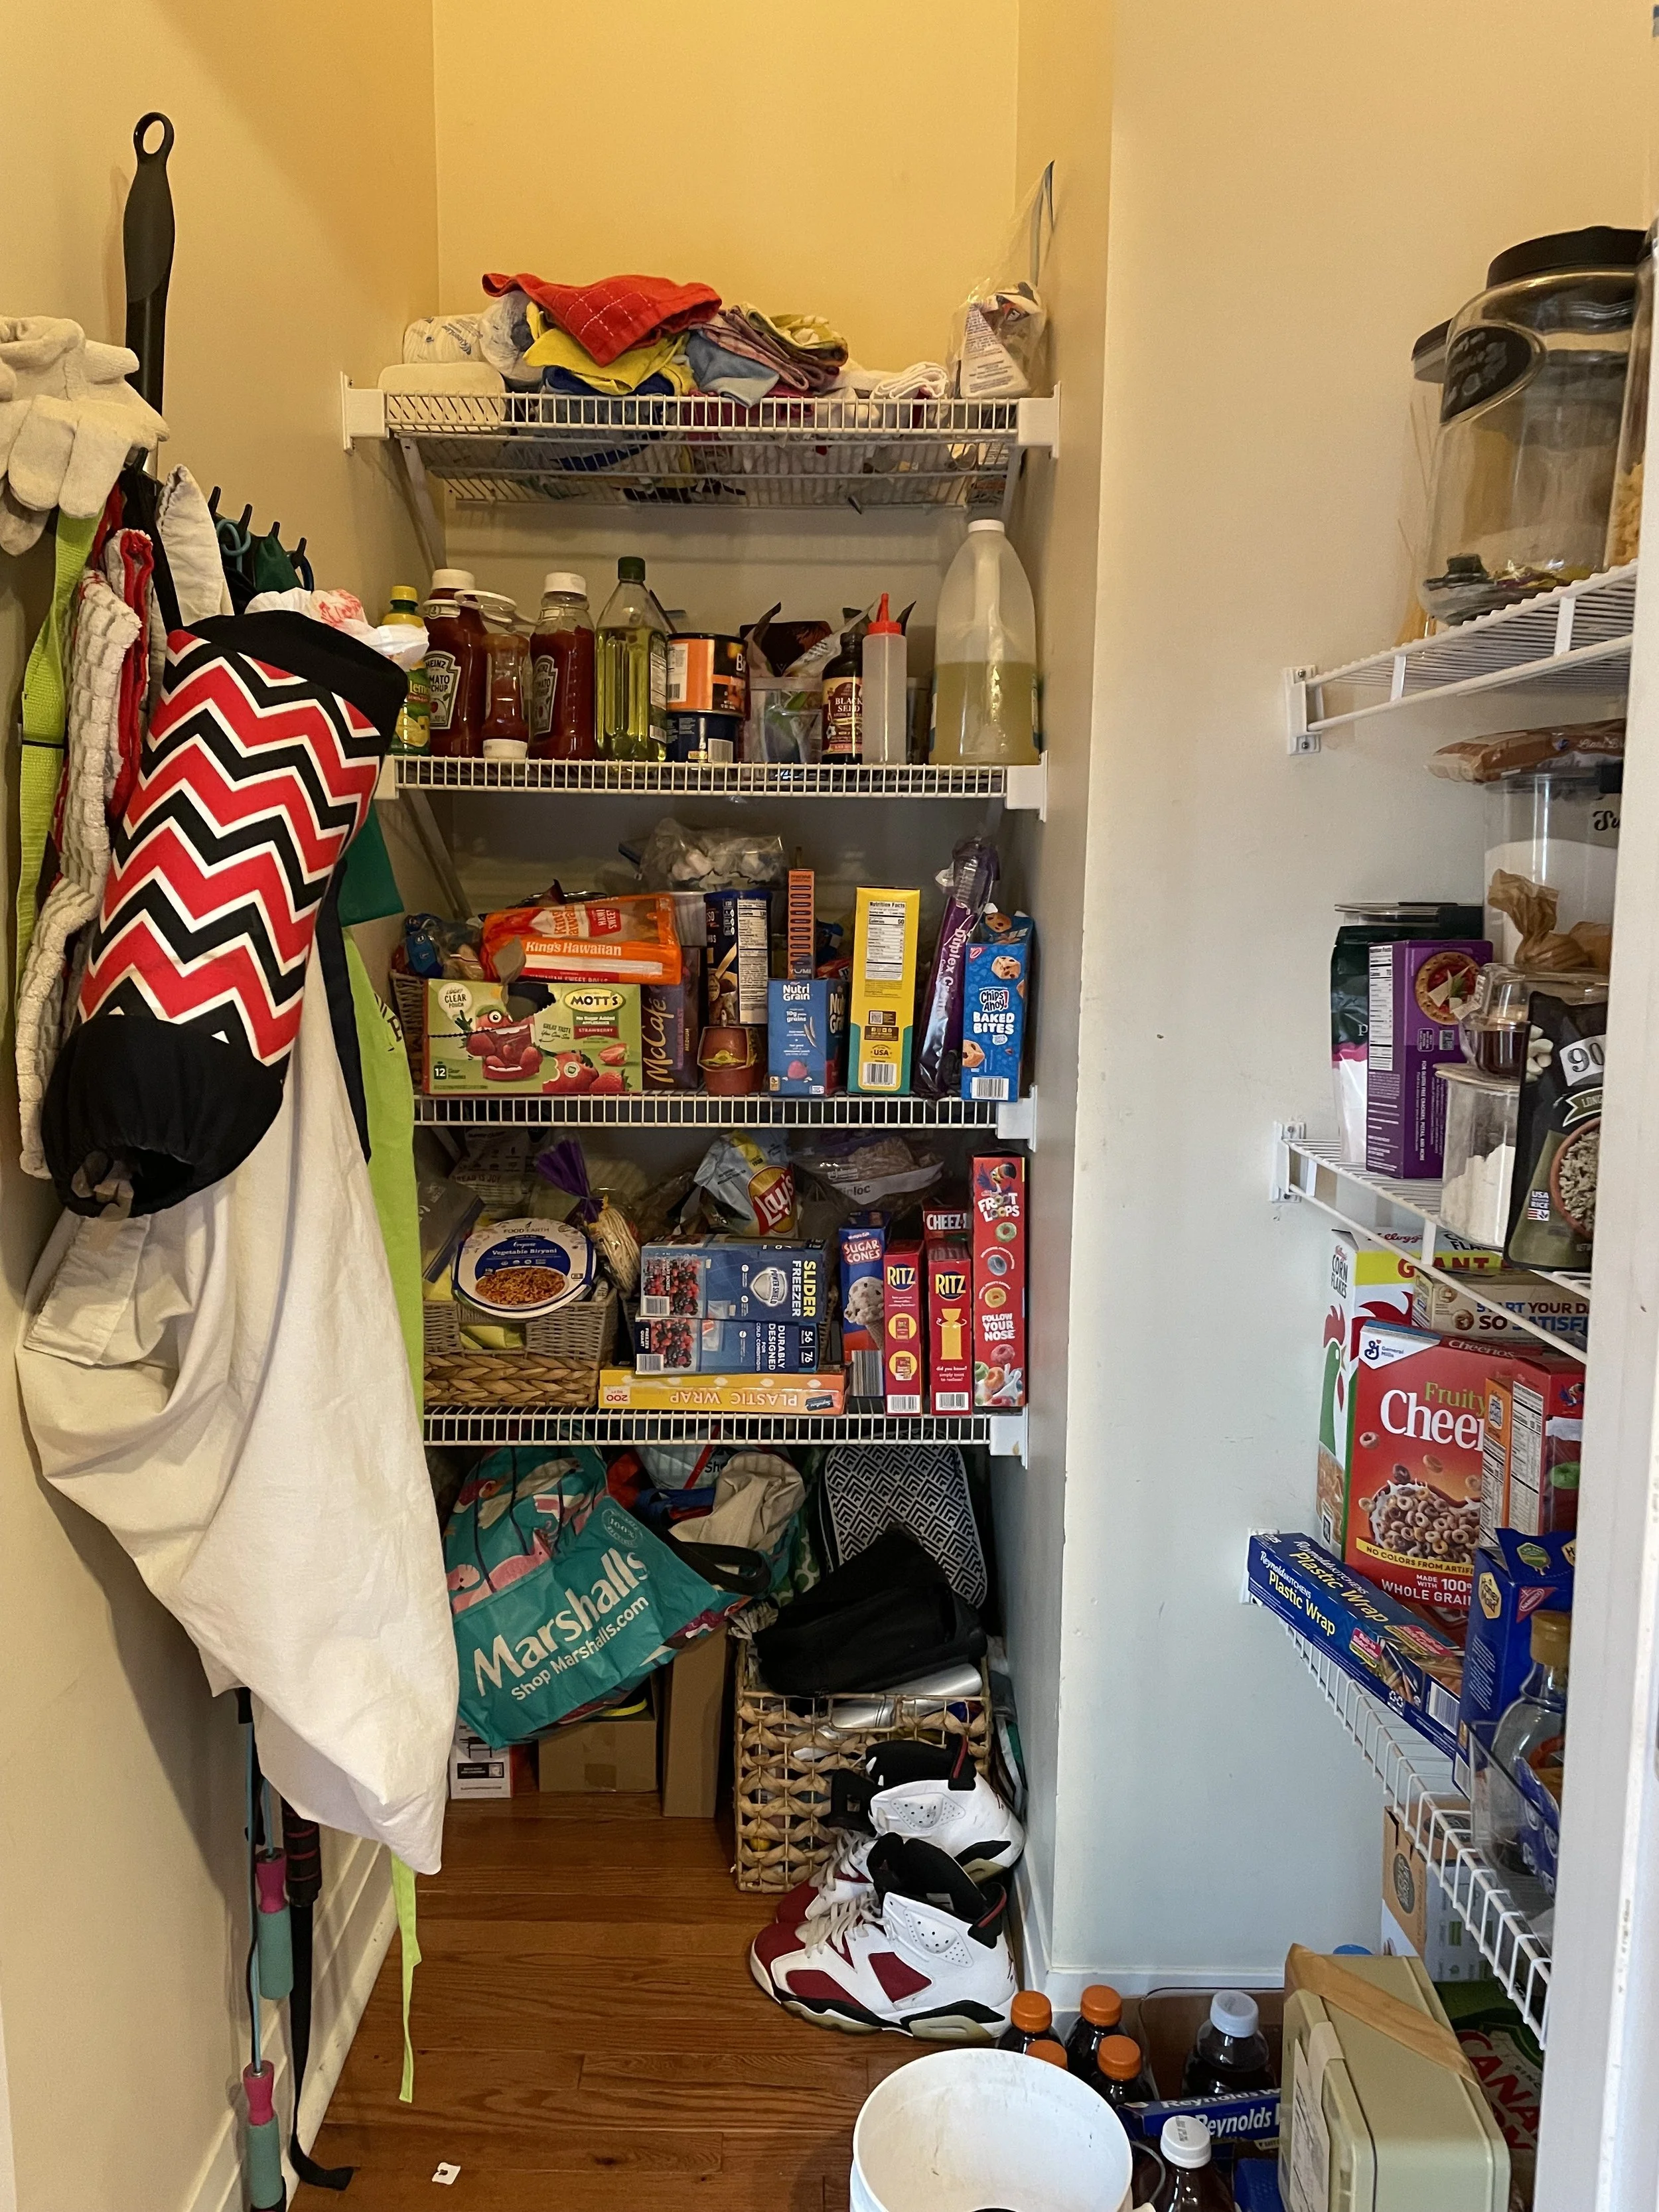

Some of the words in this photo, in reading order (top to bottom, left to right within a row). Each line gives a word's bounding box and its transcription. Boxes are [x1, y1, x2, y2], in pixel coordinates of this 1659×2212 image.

[430, 676, 450, 684] MATO
[526, 942, 561, 953] King's
[563, 942, 622, 956] Hawaiian
[783, 984, 810, 994] Nutri
[981, 991, 1003, 1003] Chips
[445, 994, 467, 1003] CLEAR
[570, 995, 618, 1005] MOTT'S
[973, 1011, 1015, 1023] BAKED
[973, 1023, 1014, 1035] BITES
[642, 997, 674, 1083] McCafé
[755, 1173, 794, 1226] Lay's
[844, 1240, 879, 1254] SUGAR
[846, 1250, 881, 1263] CONES
[1332, 1254, 1348, 1280] CORN
[770, 1270, 780, 1286] POWER
[887, 1266, 916, 1286] RITZ
[935, 1274, 966, 1294] RITZ
[792, 1260, 802, 1317] FREEZER
[804, 1260, 816, 1317] SLIDER
[1331, 1274, 1346, 1299] FLAKES
[770, 1287, 780, 1305] SHIELD
[1528, 1303, 1571, 1314] YOUR
[982, 1313, 1013, 1323] FOLLOW
[983, 1321, 1014, 1331] YOUR
[1479, 1315, 1508, 1331] SO
[805, 1331, 813, 1343] 56
[984, 1330, 1016, 1341] NOSE
[1449, 1339, 1516, 1358] Cheerios
[805, 1351, 813, 1363] 76
[670, 1391, 721, 1404] WRAP
[731, 1393, 797, 1406] PLASTIC
[1425, 1382, 1486, 1417] Fruity
[1366, 1546, 1379, 1556] NO
[1381, 1551, 1415, 1568] COLORS
[1417, 1561, 1443, 1571] FROM
[1416, 1574, 1438, 1583] MADE
[1289, 1552, 1343, 1589] Plastic
[1340, 1589, 1389, 1622] Wrap
[1381, 1579, 1429, 1600] WHOLE
[1269, 1570, 1303, 1609] Plastic
[1306, 1599, 1336, 1637] Wrap
[474, 1548, 648, 1696] Marshalls
[511, 1668, 551, 1700] Shop
[550, 1596, 649, 1674] Marshalls.com
[1161, 2092, 1259, 2108] Reynolds
[1195, 2107, 1272, 2138] Reynolds
